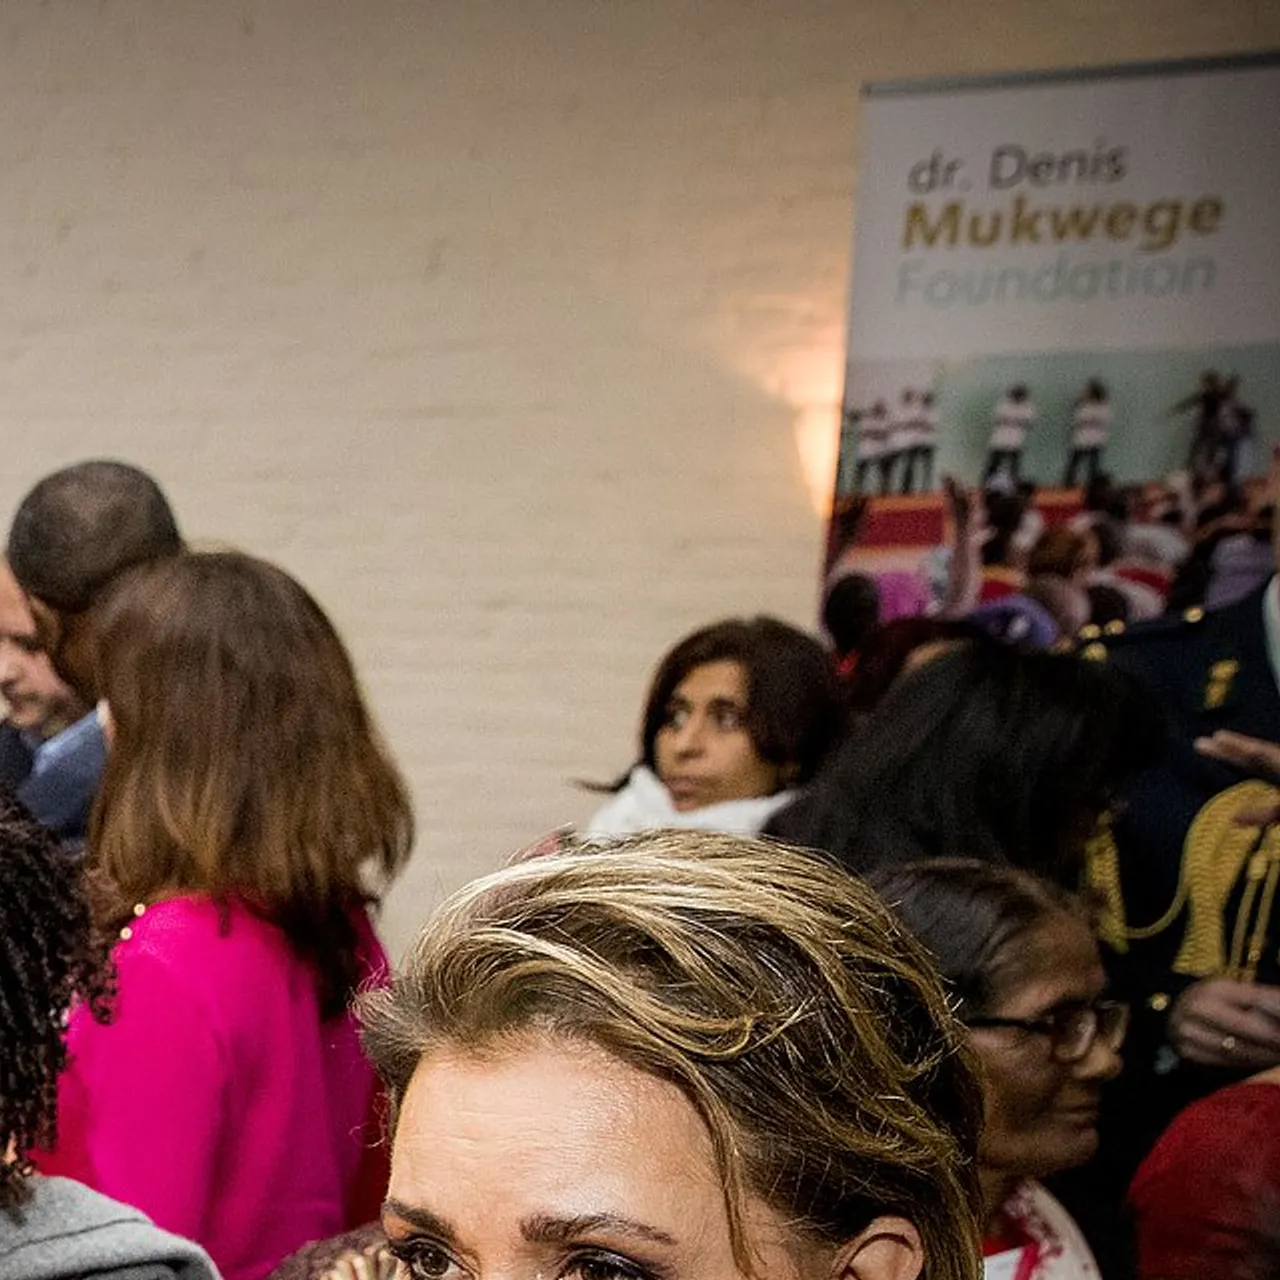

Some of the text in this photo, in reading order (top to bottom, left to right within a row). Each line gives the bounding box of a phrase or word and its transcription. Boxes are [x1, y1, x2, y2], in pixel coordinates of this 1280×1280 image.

[906, 137, 1130, 195] dr. Denis
[901, 194, 1225, 253] Mukwege
[894, 254, 1219, 310] Foundation
